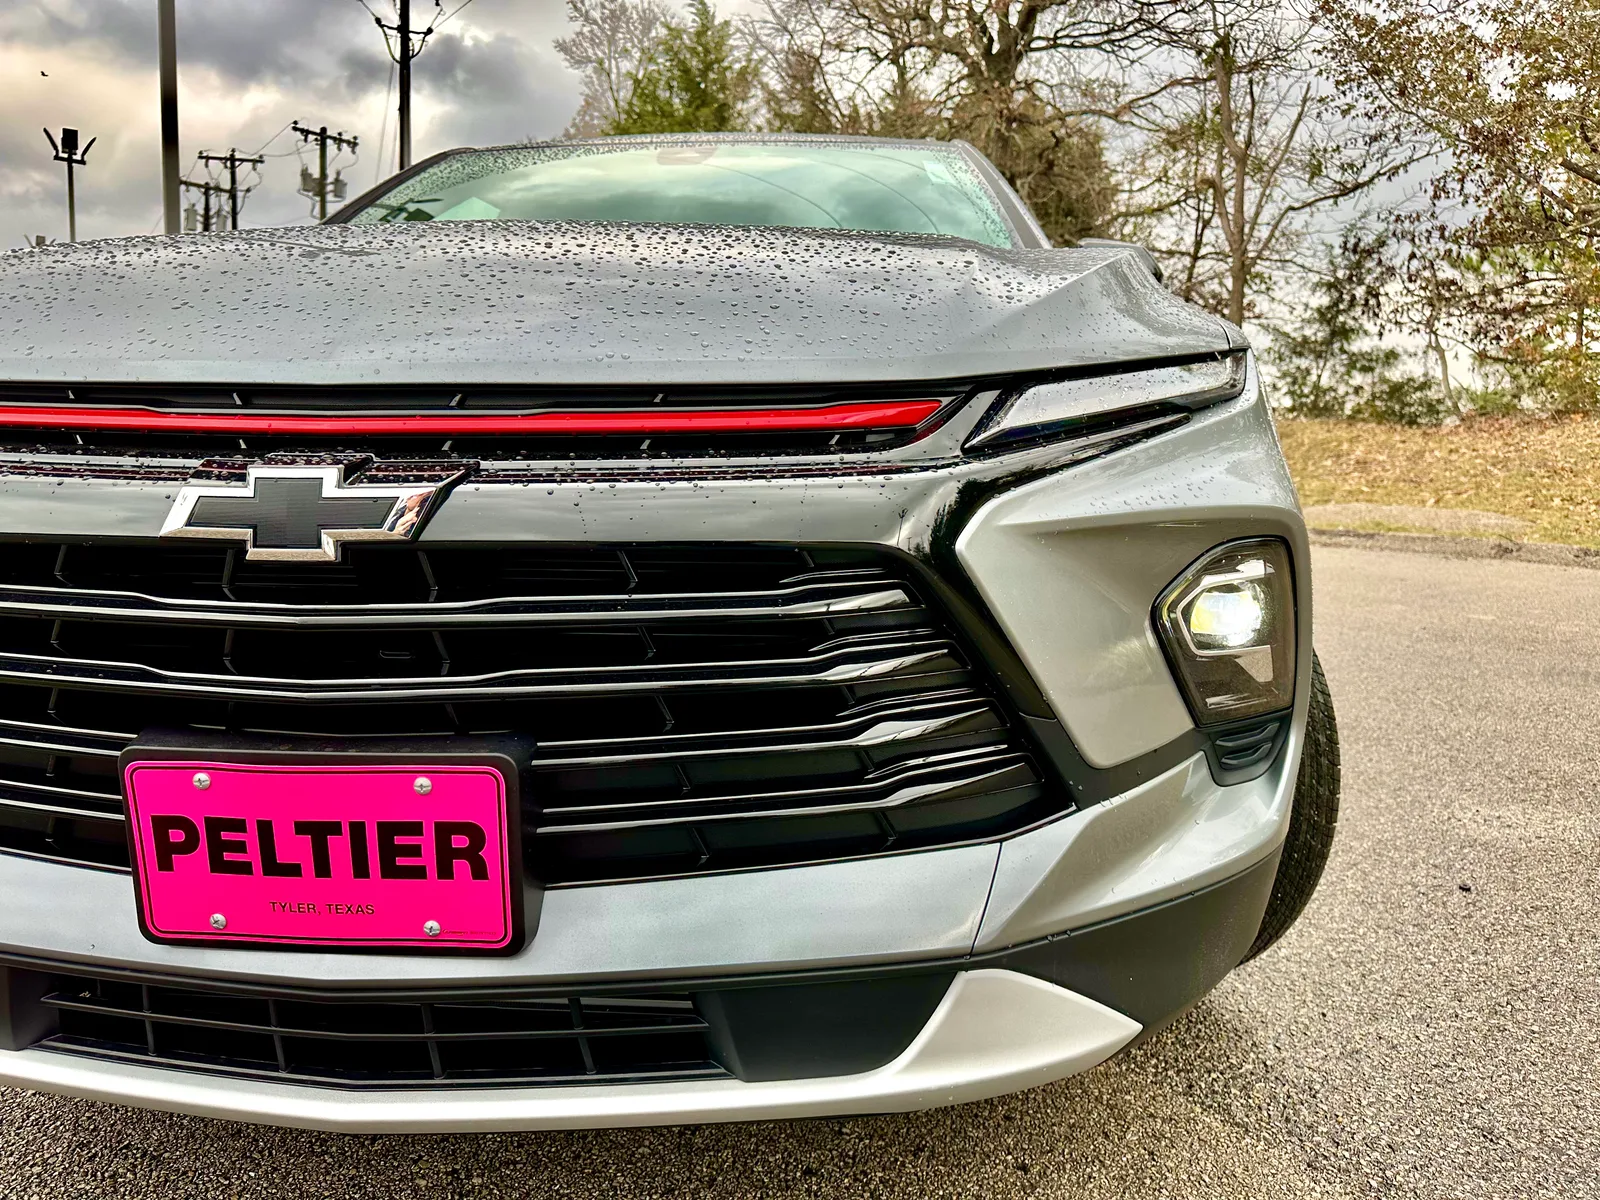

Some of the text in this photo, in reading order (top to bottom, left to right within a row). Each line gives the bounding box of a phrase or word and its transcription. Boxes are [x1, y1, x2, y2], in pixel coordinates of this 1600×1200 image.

[150, 814, 490, 881] PELTIER
[269, 901, 375, 916] TYLER, TEXAS
